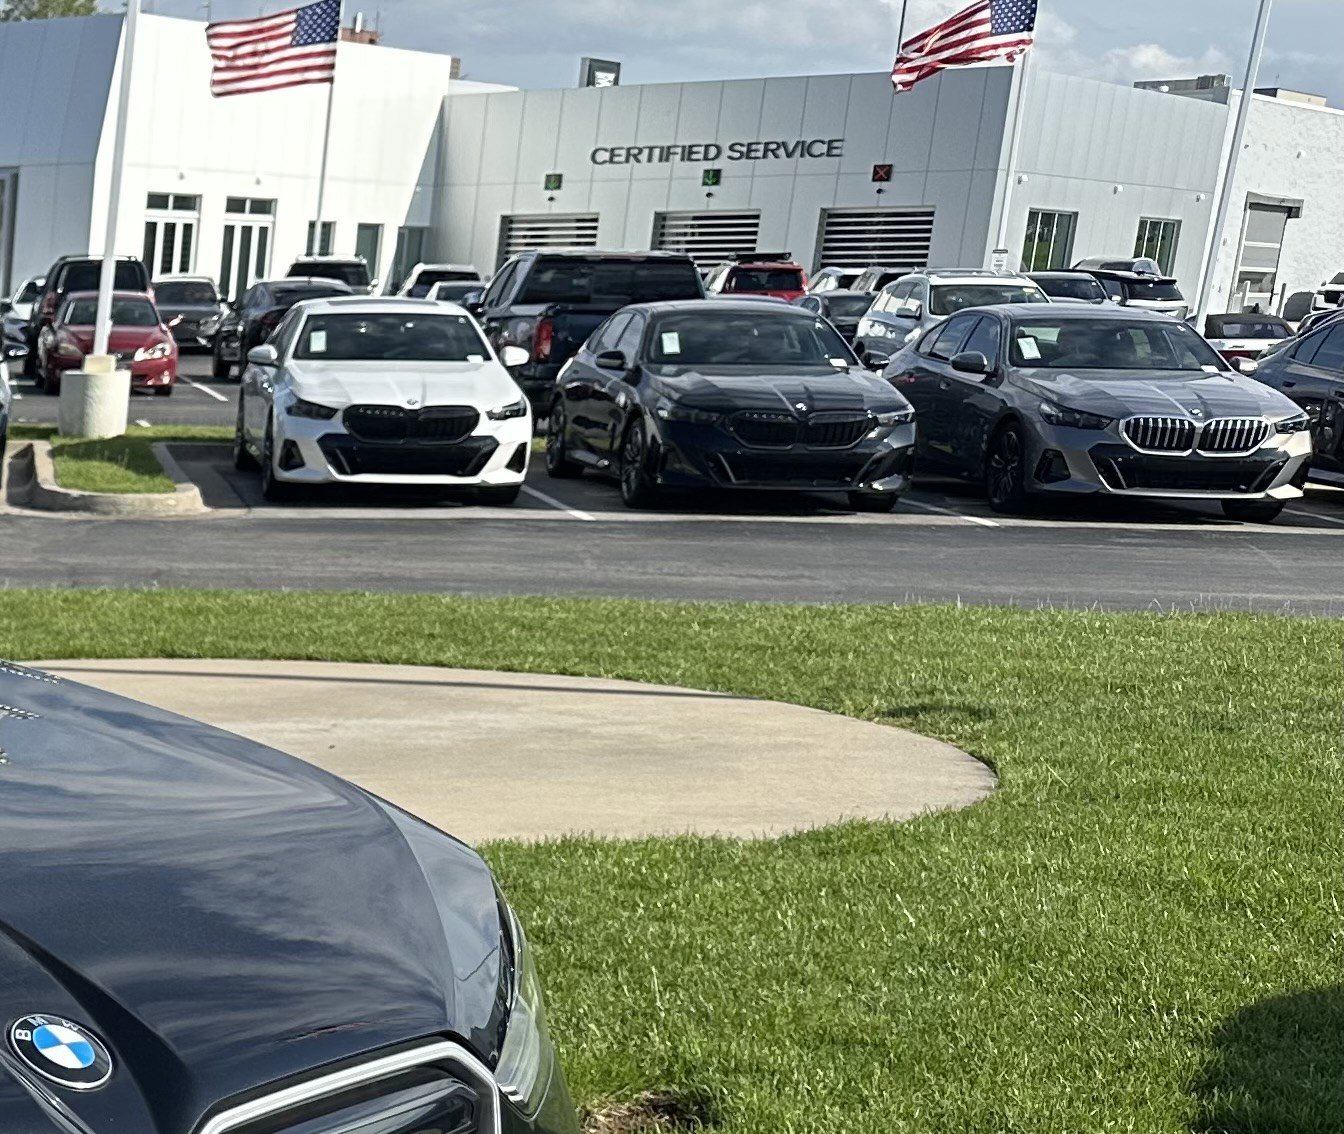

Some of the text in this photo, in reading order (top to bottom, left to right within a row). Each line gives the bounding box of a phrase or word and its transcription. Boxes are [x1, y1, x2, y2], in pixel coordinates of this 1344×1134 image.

[591, 138, 845, 165] CERTIFIED SERVICE
[14, 1015, 80, 1042] BMW
